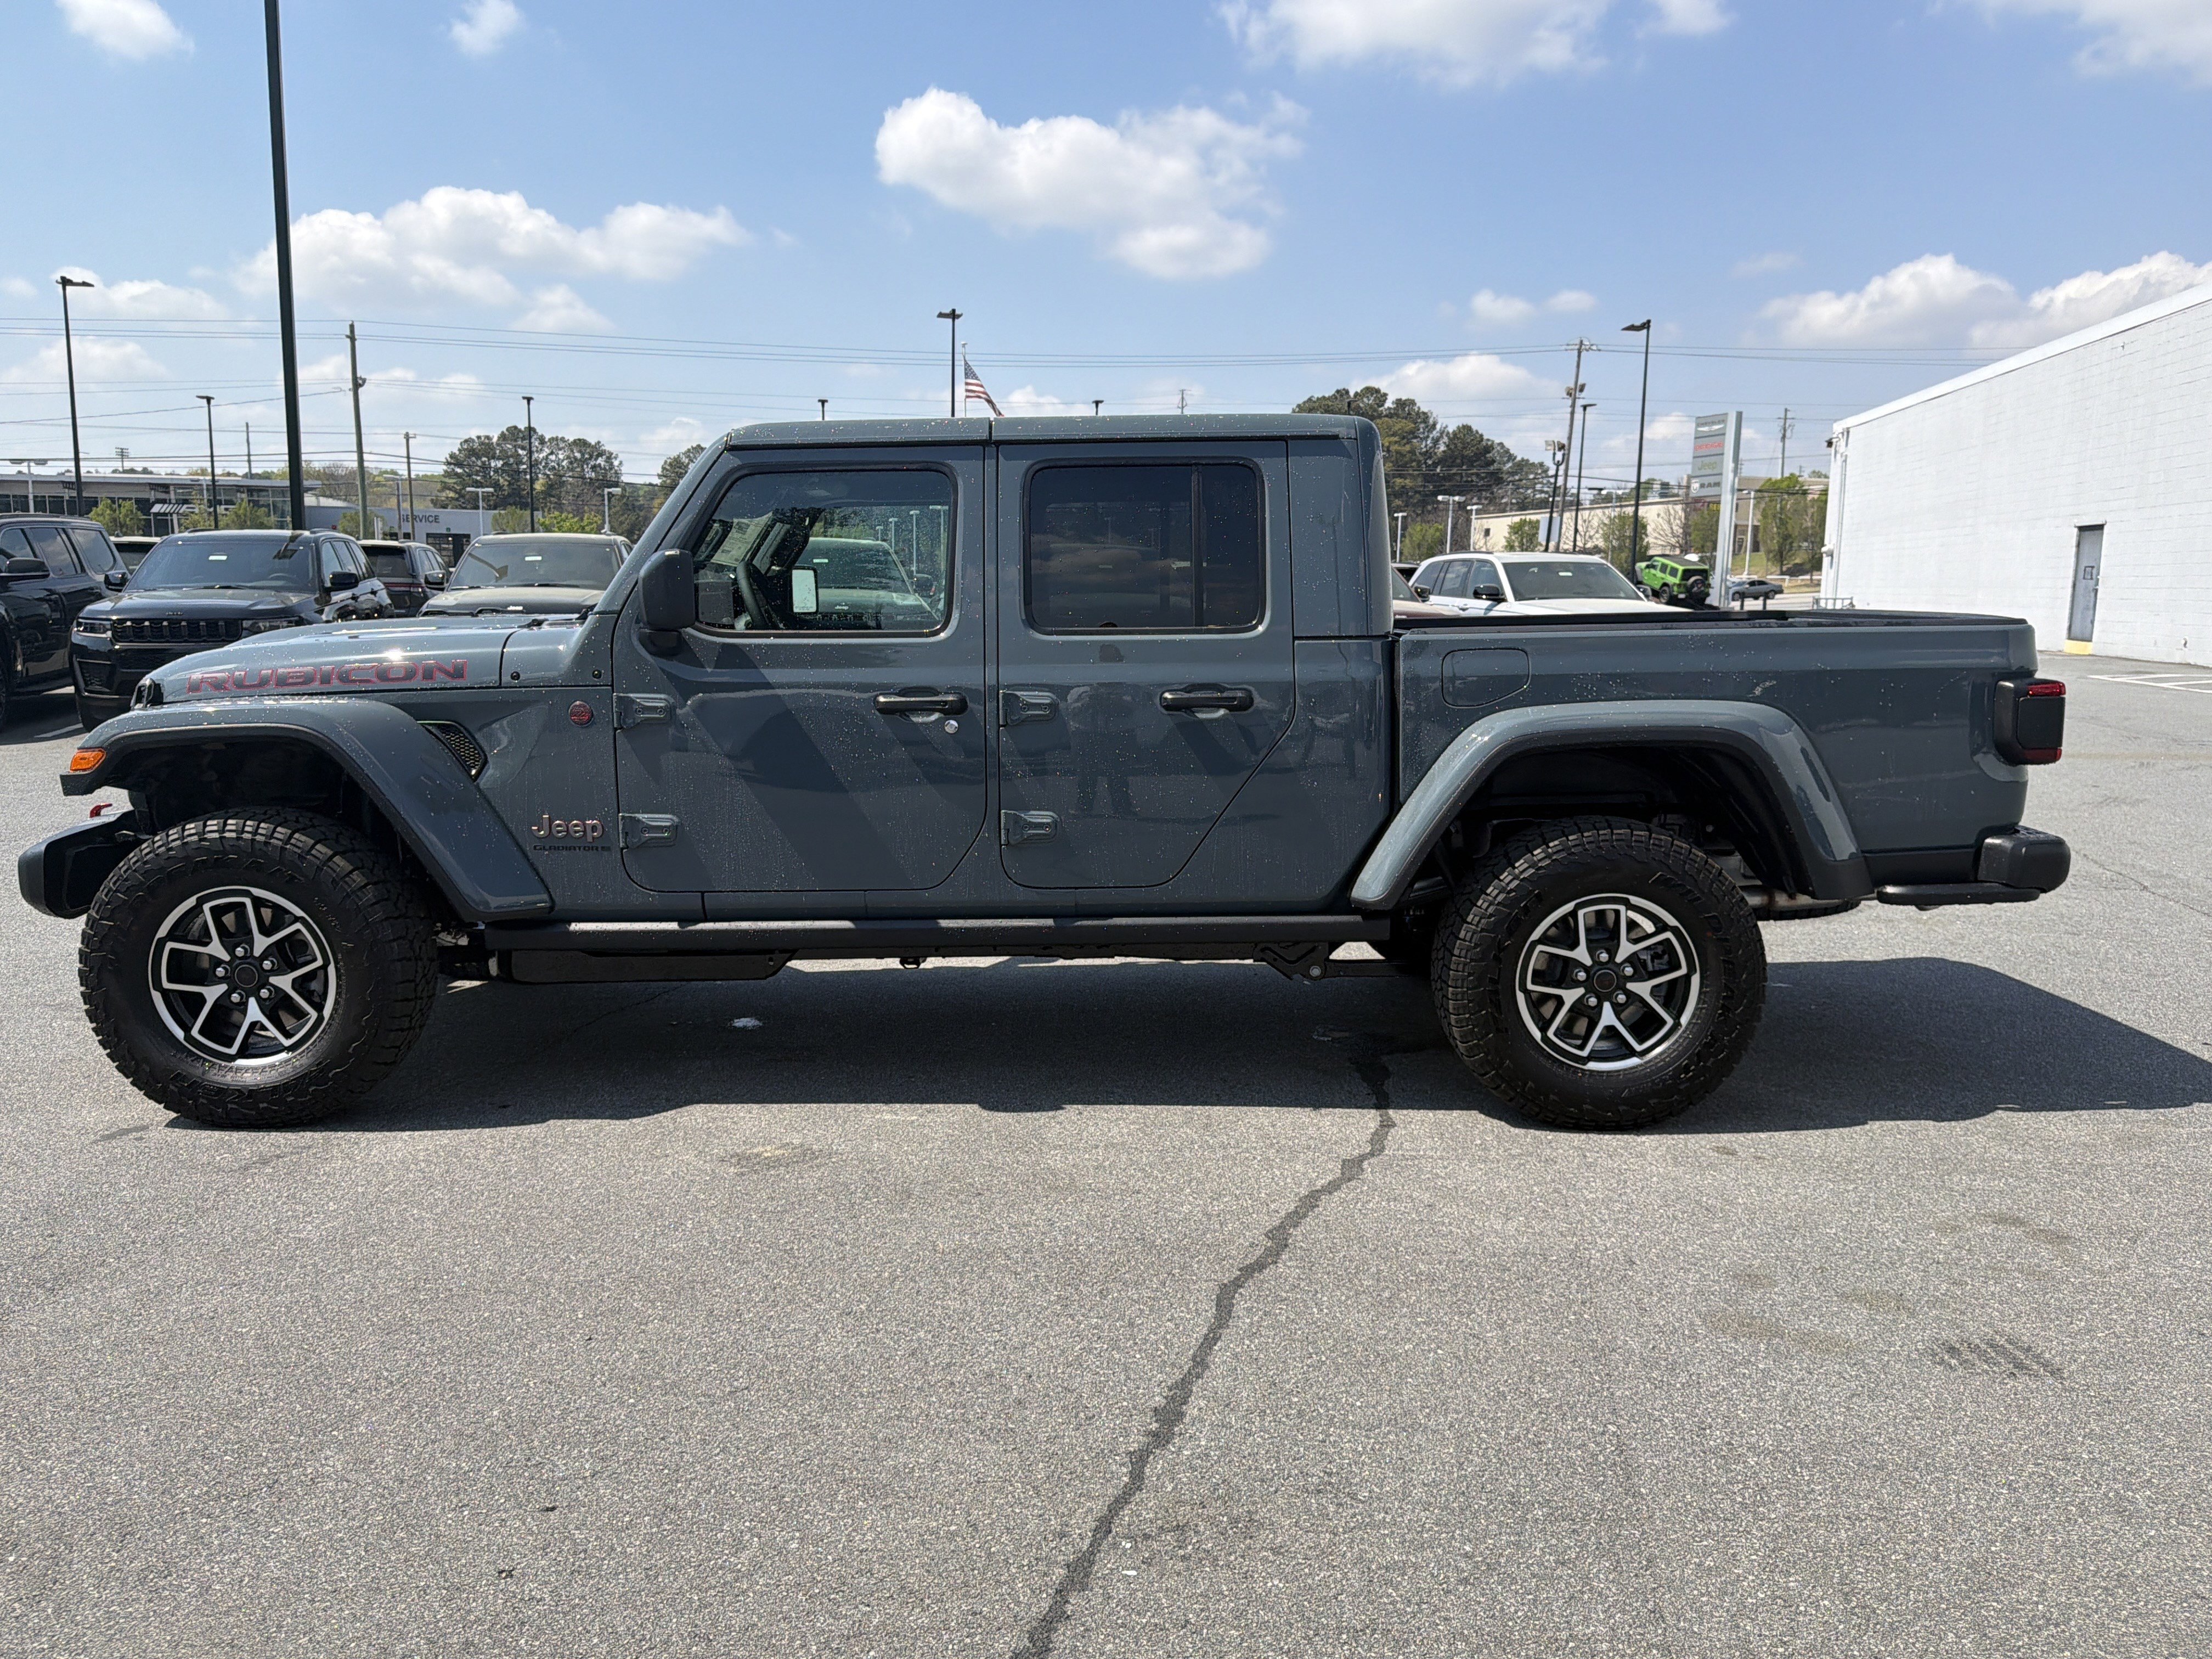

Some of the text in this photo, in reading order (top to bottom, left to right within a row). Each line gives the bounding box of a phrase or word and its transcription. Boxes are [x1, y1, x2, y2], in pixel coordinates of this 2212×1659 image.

[1698, 461, 1717, 470] Jeep
[187, 659, 467, 693] RUBICON
[531, 815, 603, 842] Jeep
